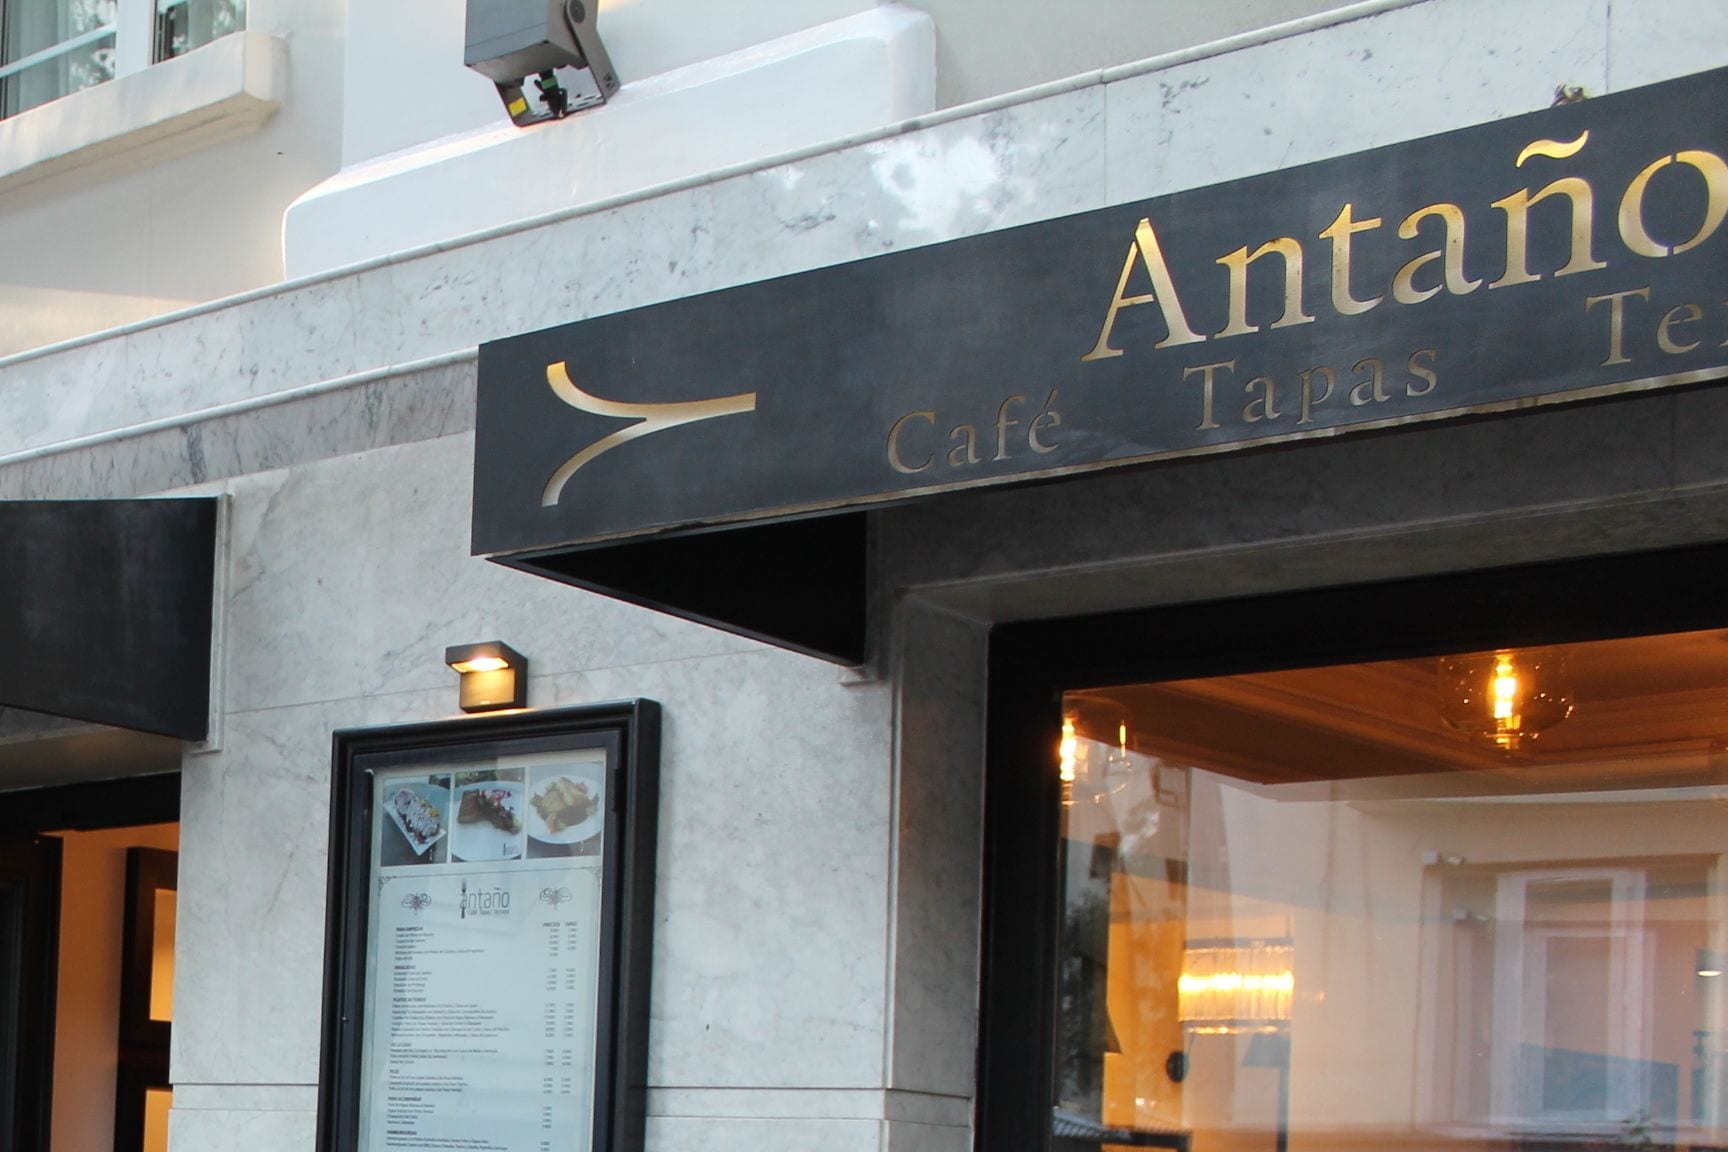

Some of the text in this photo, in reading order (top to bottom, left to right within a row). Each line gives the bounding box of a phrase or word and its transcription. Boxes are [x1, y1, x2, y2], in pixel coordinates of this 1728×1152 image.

[1080, 128, 1728, 364] Antaño
[885, 285, 1728, 475] Café Tapas Te
